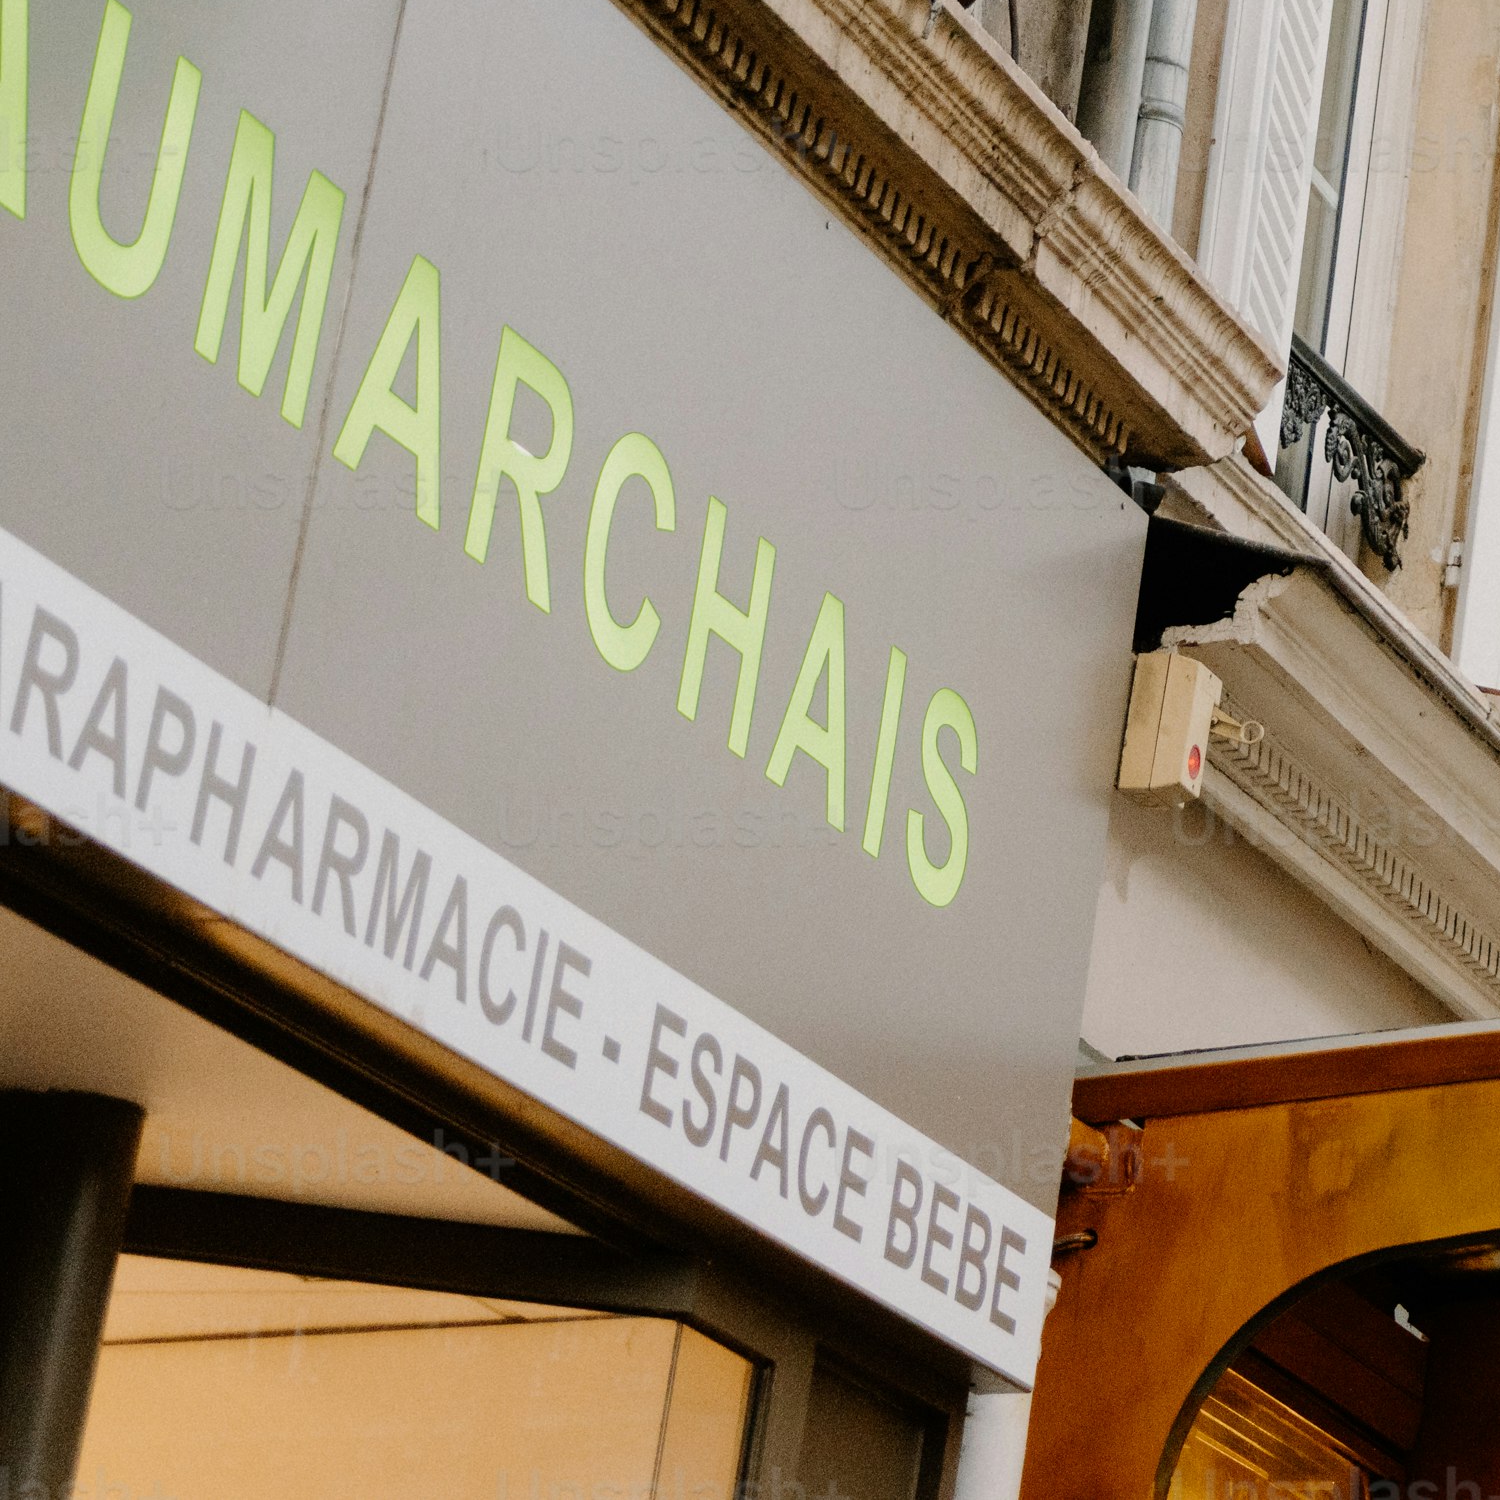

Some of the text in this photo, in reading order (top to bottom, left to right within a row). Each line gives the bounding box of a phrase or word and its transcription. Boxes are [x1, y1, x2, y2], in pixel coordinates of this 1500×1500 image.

[0, 602, 1028, 1337] RAPHARMACIE - ESPACE BEBE
